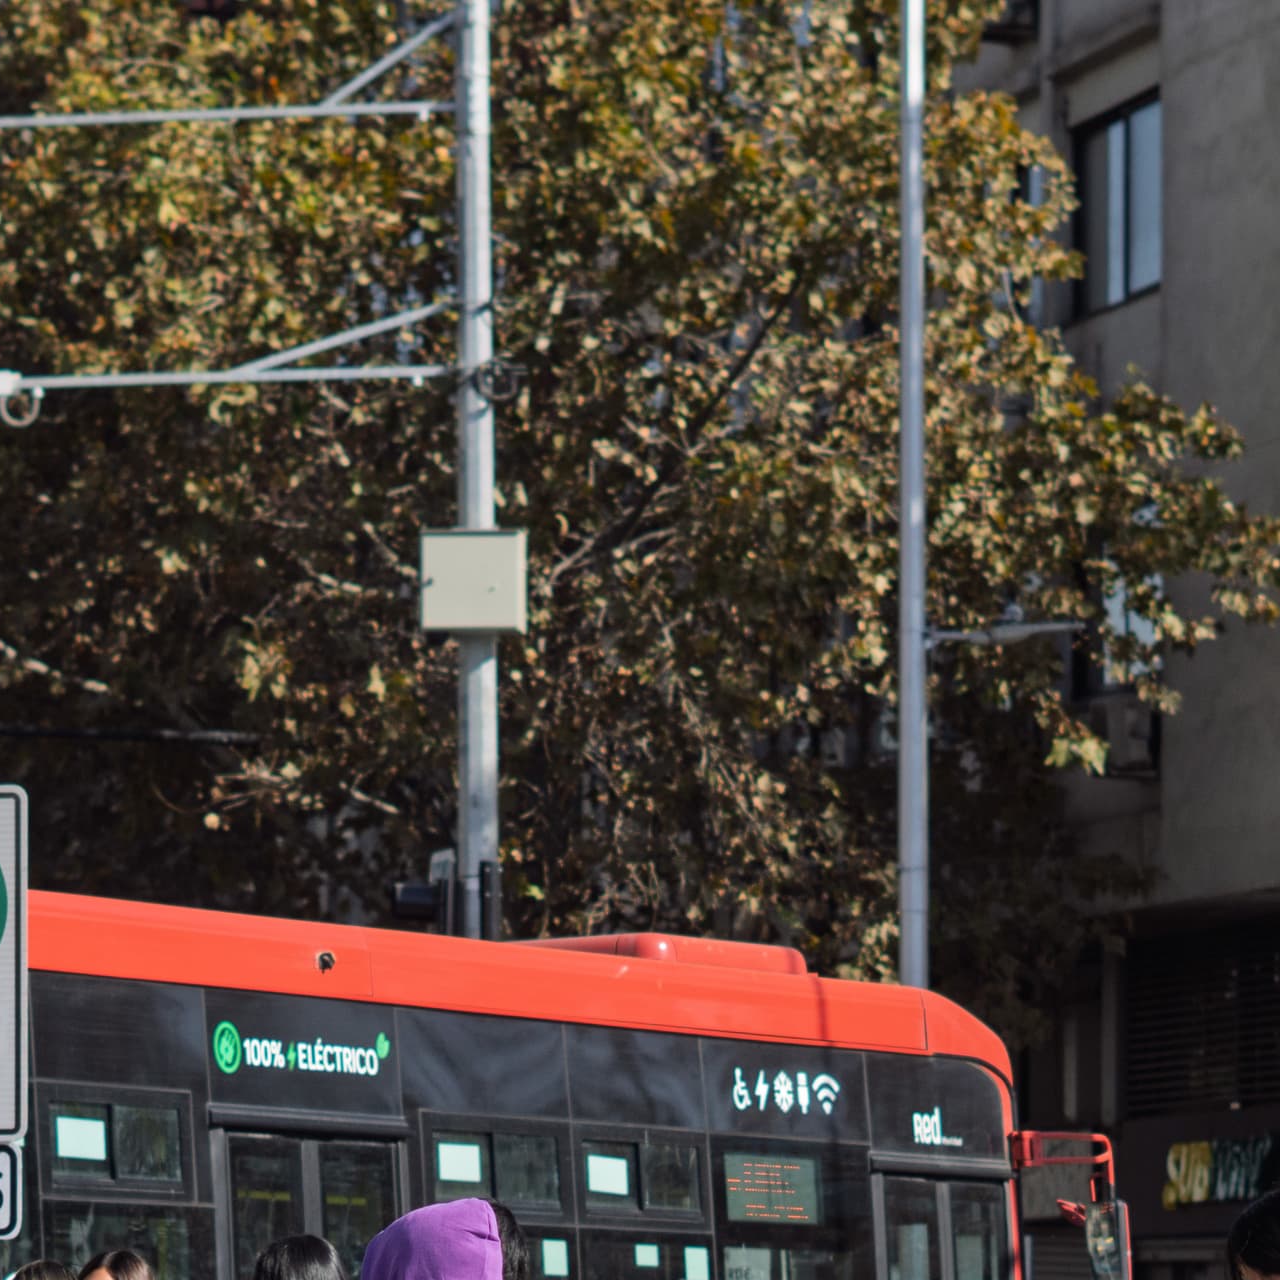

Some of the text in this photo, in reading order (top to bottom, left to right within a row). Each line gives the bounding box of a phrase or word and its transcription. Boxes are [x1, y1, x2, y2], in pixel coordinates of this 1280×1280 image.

[243, 1037, 379, 1076] 100% ELÉCTRICO
[913, 1107, 941, 1144] Red
